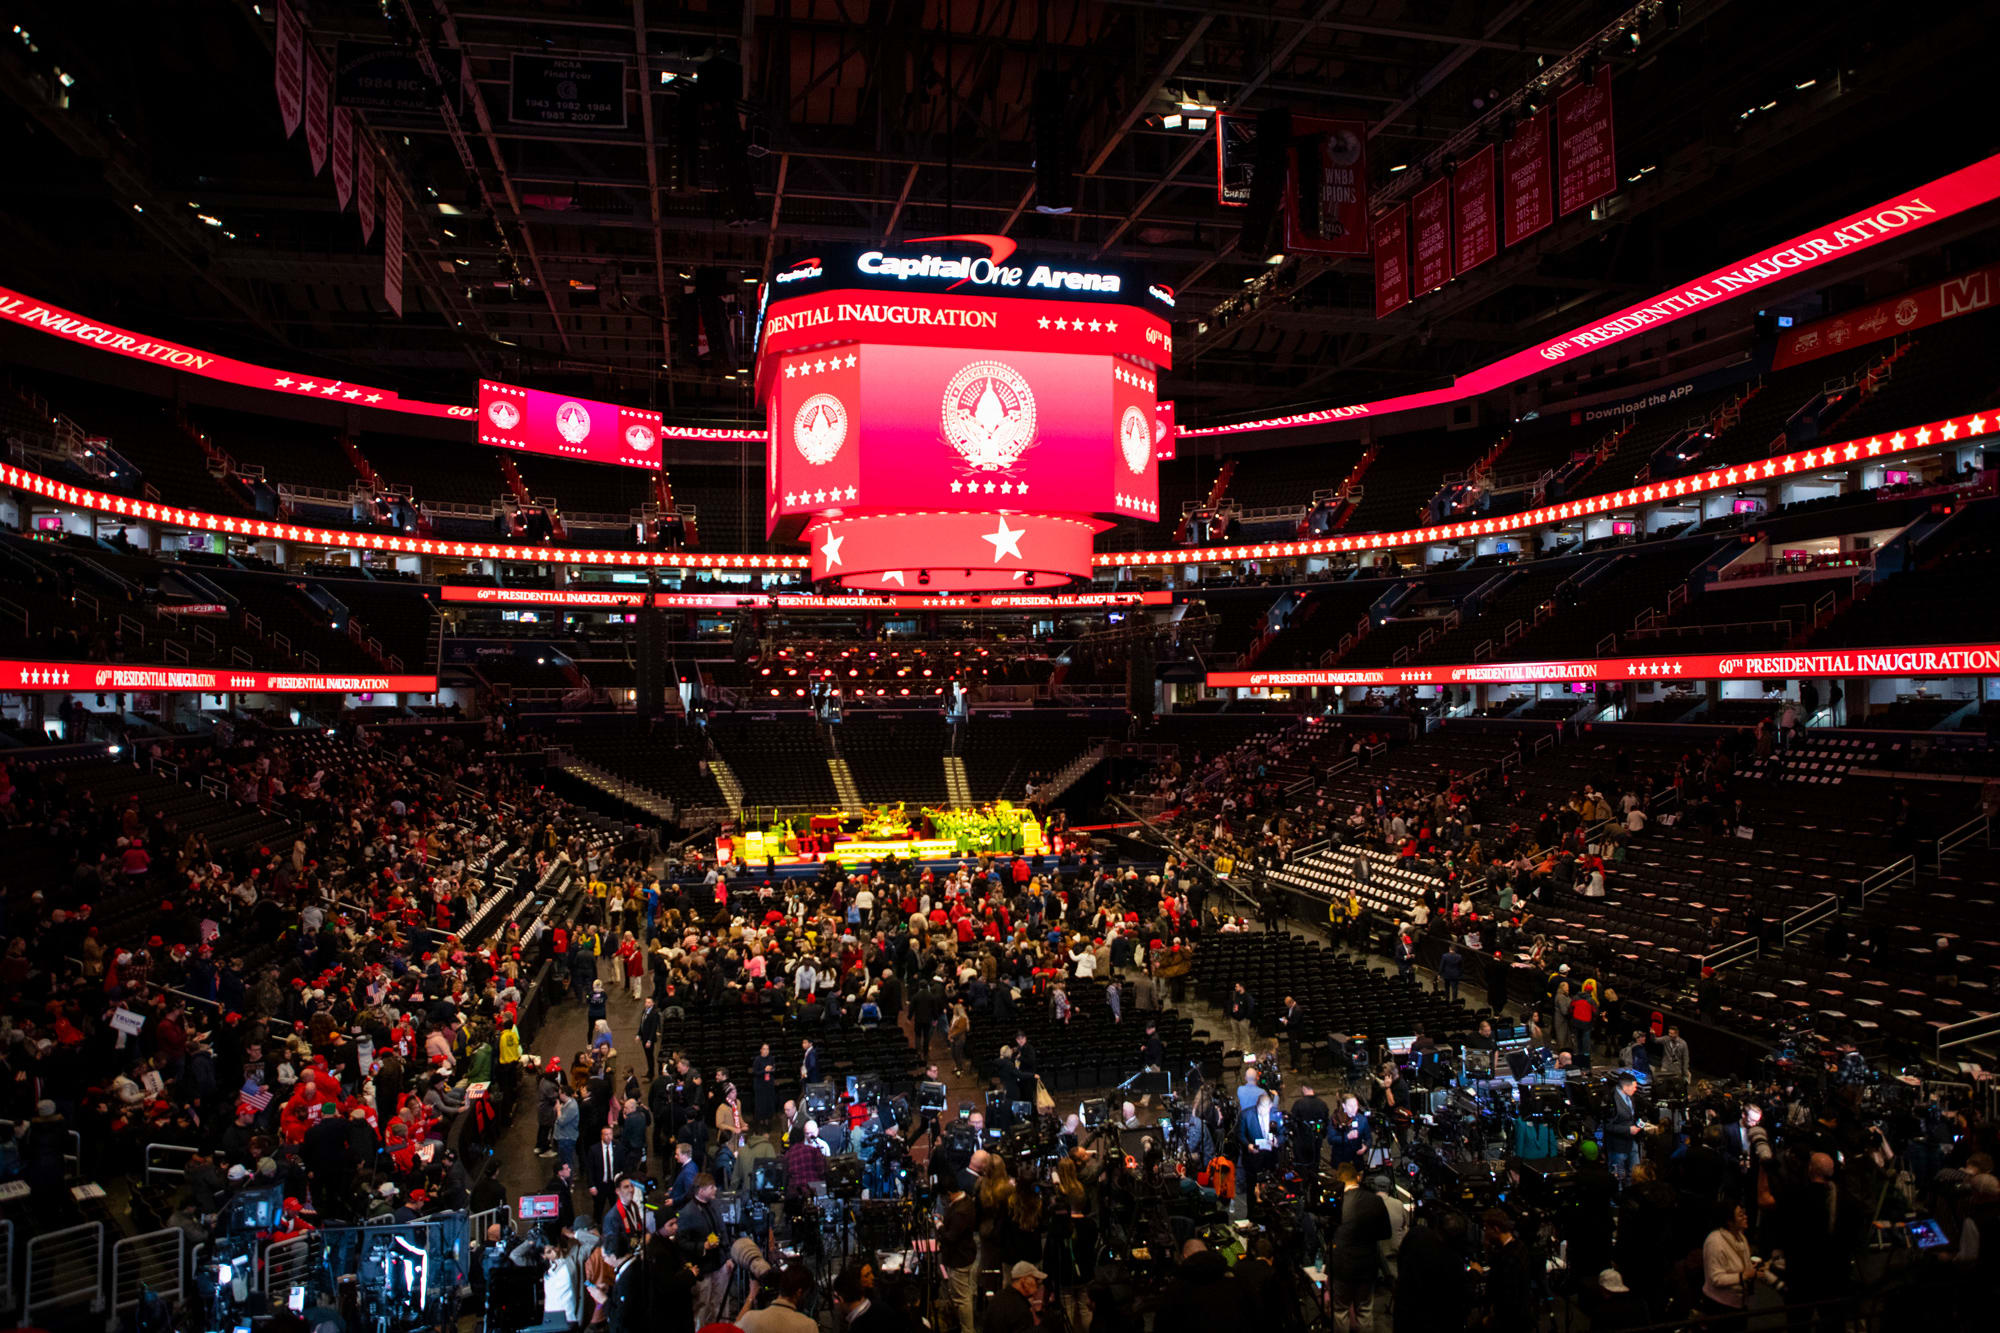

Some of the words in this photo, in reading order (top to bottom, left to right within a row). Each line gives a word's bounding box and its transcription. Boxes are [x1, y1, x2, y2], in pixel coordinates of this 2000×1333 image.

[1325, 168, 1355, 185] WNBA
[1323, 185, 1358, 204] PIONS
[1027, 266, 1121, 292] Arena
[1540, 341, 1571, 361] 60TH
[1570, 285, 1723, 348] PRESIDENTIAL
[1711, 197, 1937, 292] INAUGURATION
[838, 304, 998, 329] INAUGURATION
[19, 307, 214, 369] INAUGURATION
[1586, 398, 1646, 421] Download
[1648, 394, 1667, 406] the
[1668, 384, 1694, 401] APP
[497, 590, 565, 602] PRESIDENTIAL
[566, 593, 641, 604] INAUGURATION
[1718, 659, 1743, 674] 60TH
[1746, 655, 1854, 674] PRESIDENTIAL
[1857, 650, 2000, 672] INAUGURATION
[95, 669, 112, 686] 60TH
[113, 670, 168, 687] PRESIDENTIAL
[168, 672, 216, 687] INAUGURATION
[1269, 673, 1328, 684] PRESIDENTIAL
[1328, 672, 1384, 683] INAUGURATION
[1466, 666, 1525, 680] PRESIDENTIAL
[1525, 664, 1597, 679] INAUGURATION
[326, 678, 389, 689] INAUGURATION
